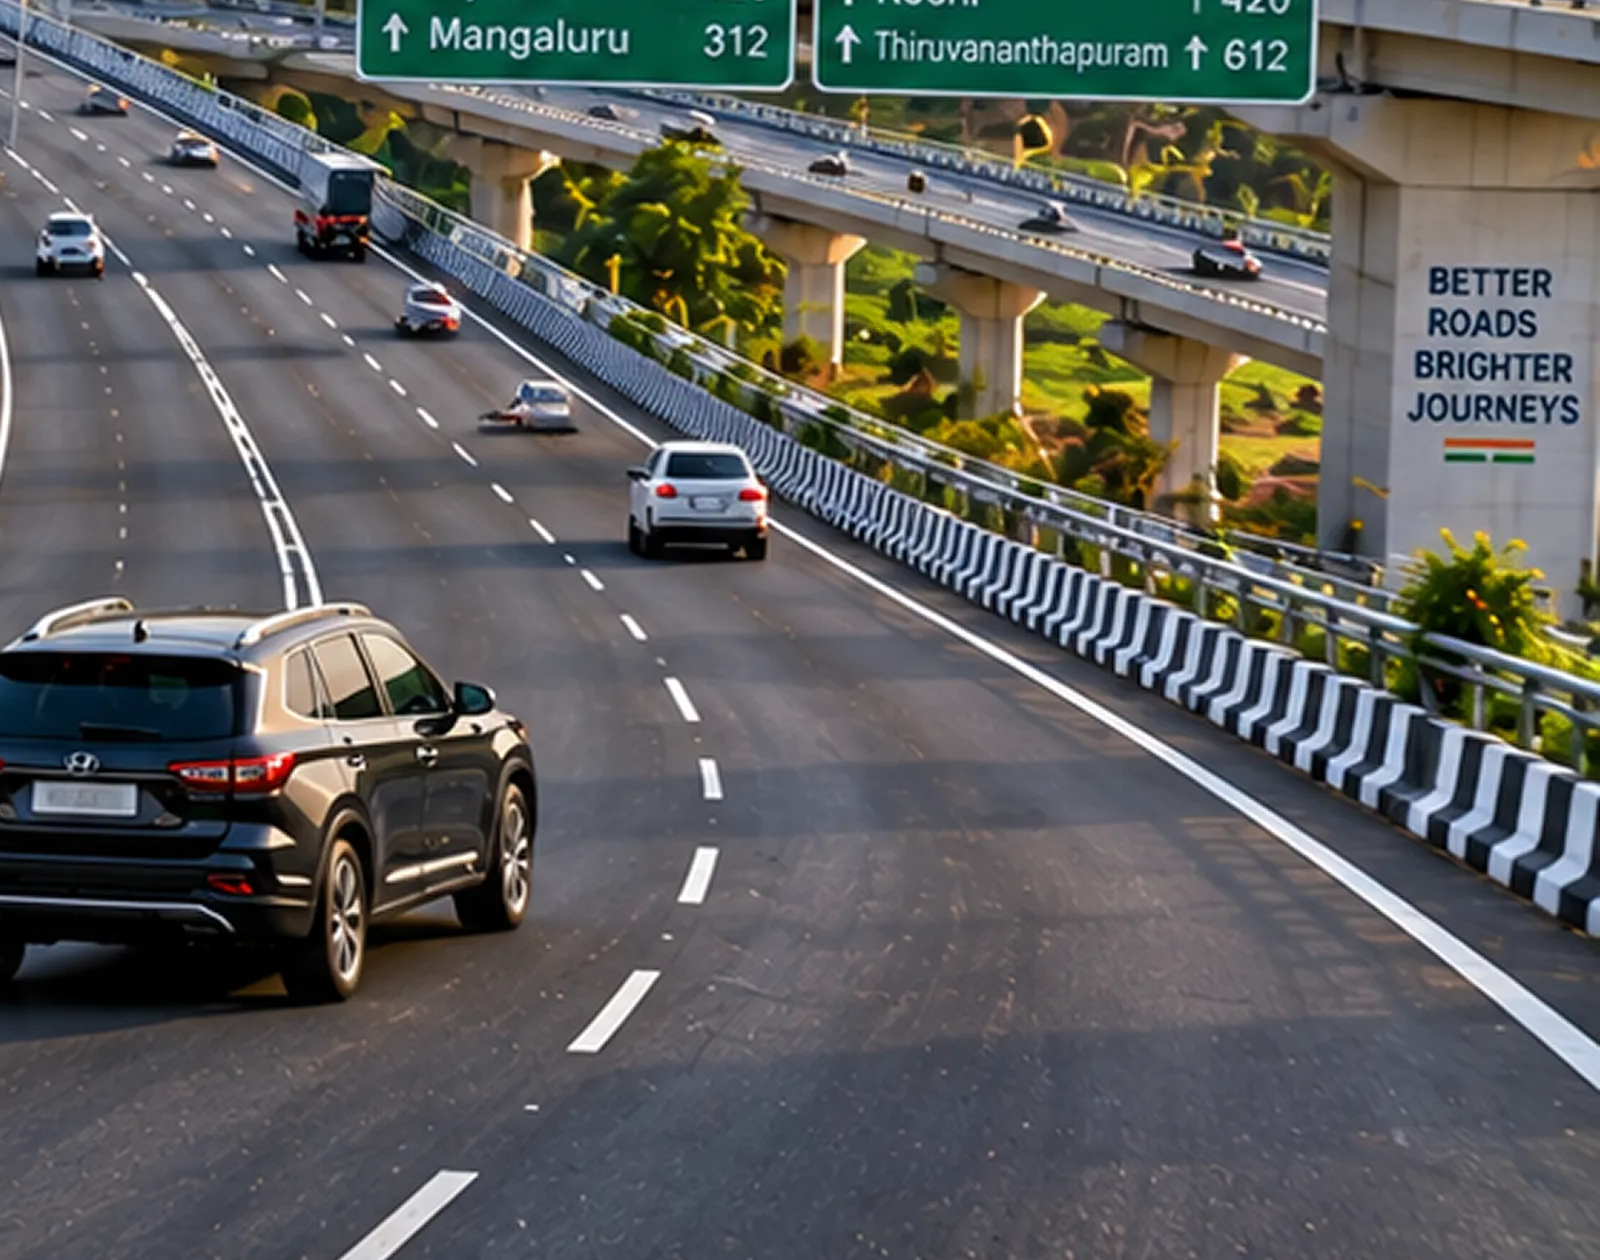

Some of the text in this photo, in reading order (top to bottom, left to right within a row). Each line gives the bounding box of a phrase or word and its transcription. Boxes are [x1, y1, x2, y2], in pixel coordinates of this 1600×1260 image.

[429, 16, 768, 60] Mangaluru 312
[874, 30, 1289, 72] Thiruvananthapuram 612
[1428, 266, 1552, 297] BETTER
[1428, 307, 1537, 338] ROADS
[1415, 350, 1573, 383] BRIGHTER
[1407, 392, 1580, 424] JOURNEYS
